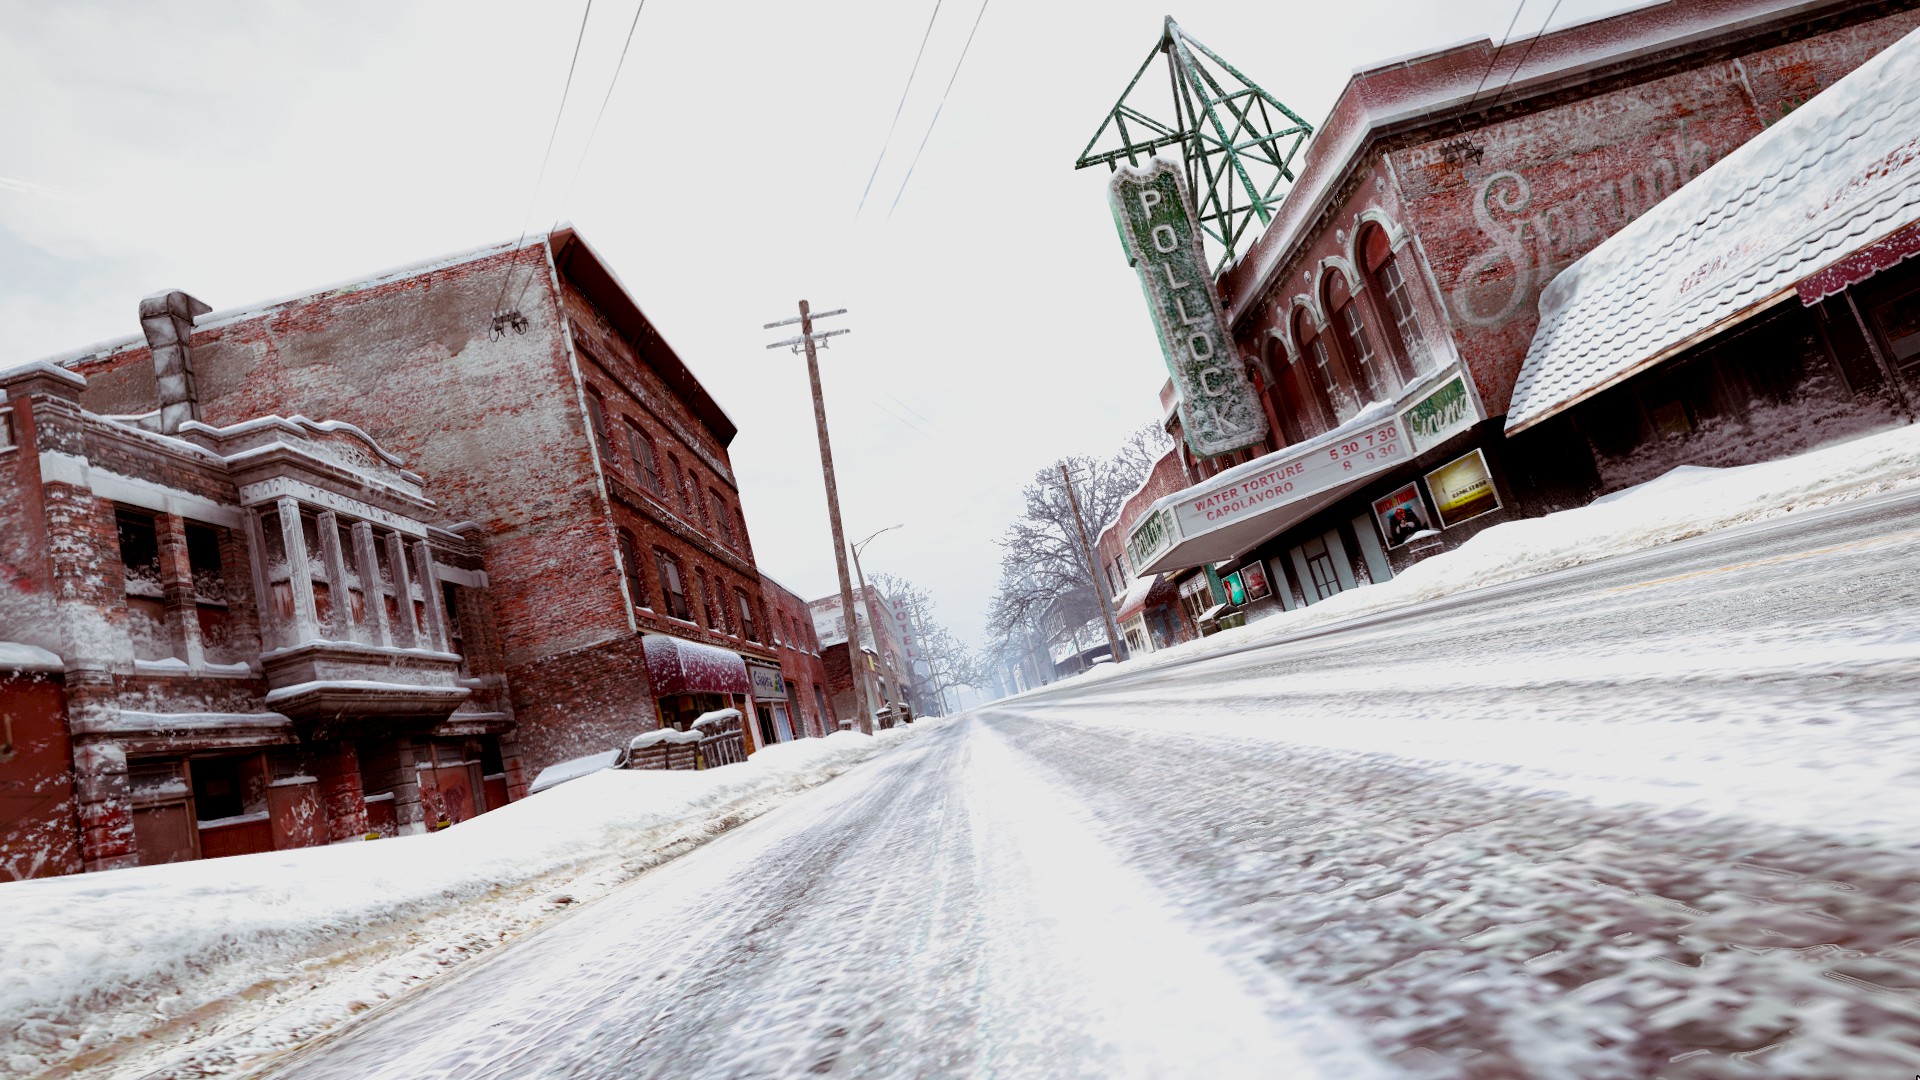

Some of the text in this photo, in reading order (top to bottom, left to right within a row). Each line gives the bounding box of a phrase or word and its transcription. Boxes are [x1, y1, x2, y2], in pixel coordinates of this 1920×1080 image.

[1138, 190, 1240, 435] POLLOCK
[1365, 434, 1374, 447] 7
[1378, 426, 1397, 443] 30
[1410, 393, 1468, 437] Cinema
[1342, 443, 1398, 472] 8 9 30
[1194, 462, 1305, 512] WATER TORTURE
[1206, 481, 1294, 521] CAPOLAVORO
[892, 599, 917, 658] HOTEL
